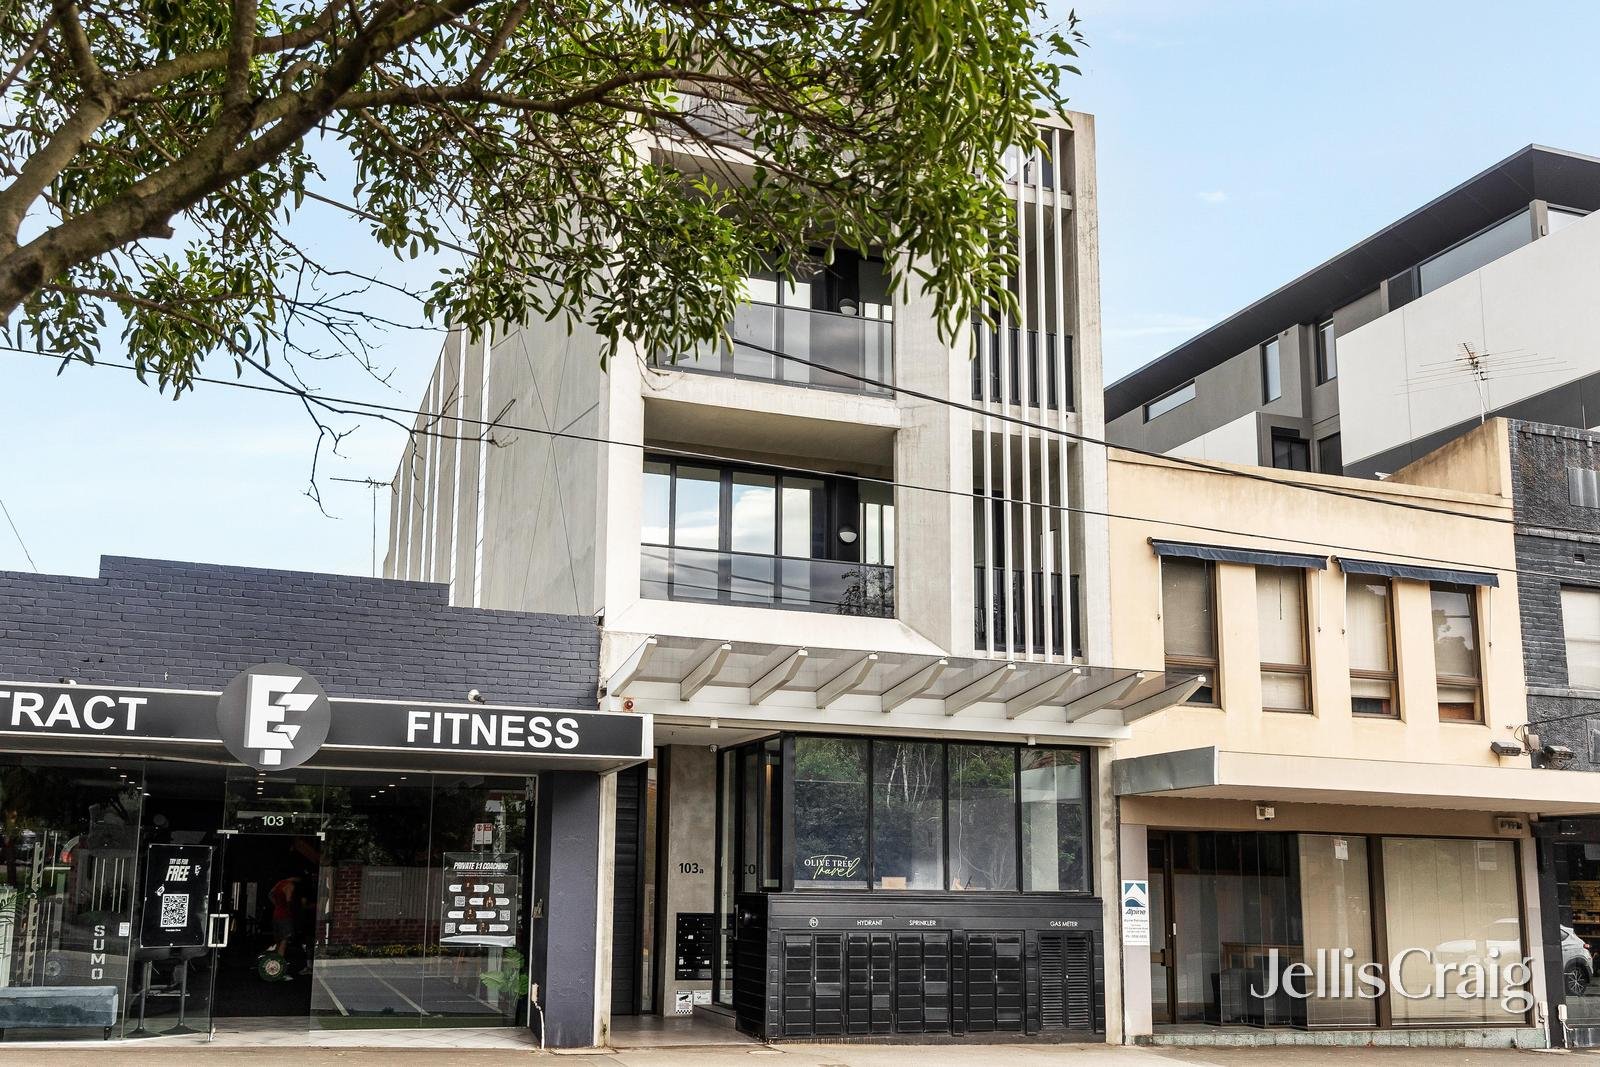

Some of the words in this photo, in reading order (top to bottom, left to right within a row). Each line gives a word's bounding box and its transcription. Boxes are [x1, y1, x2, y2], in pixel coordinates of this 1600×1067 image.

[407, 711, 580, 750] FITNESS
[262, 815, 284, 827] 103
[453, 861, 475, 870] PRIVATE
[482, 862, 509, 870] COACHING
[678, 862, 705, 874] 103a
[804, 859, 831, 867] OLIVE
[832, 860, 853, 868] TREE
[811, 854, 861, 880] Travel
[165, 865, 190, 882] FREE
[90, 925, 105, 980] SUMO
